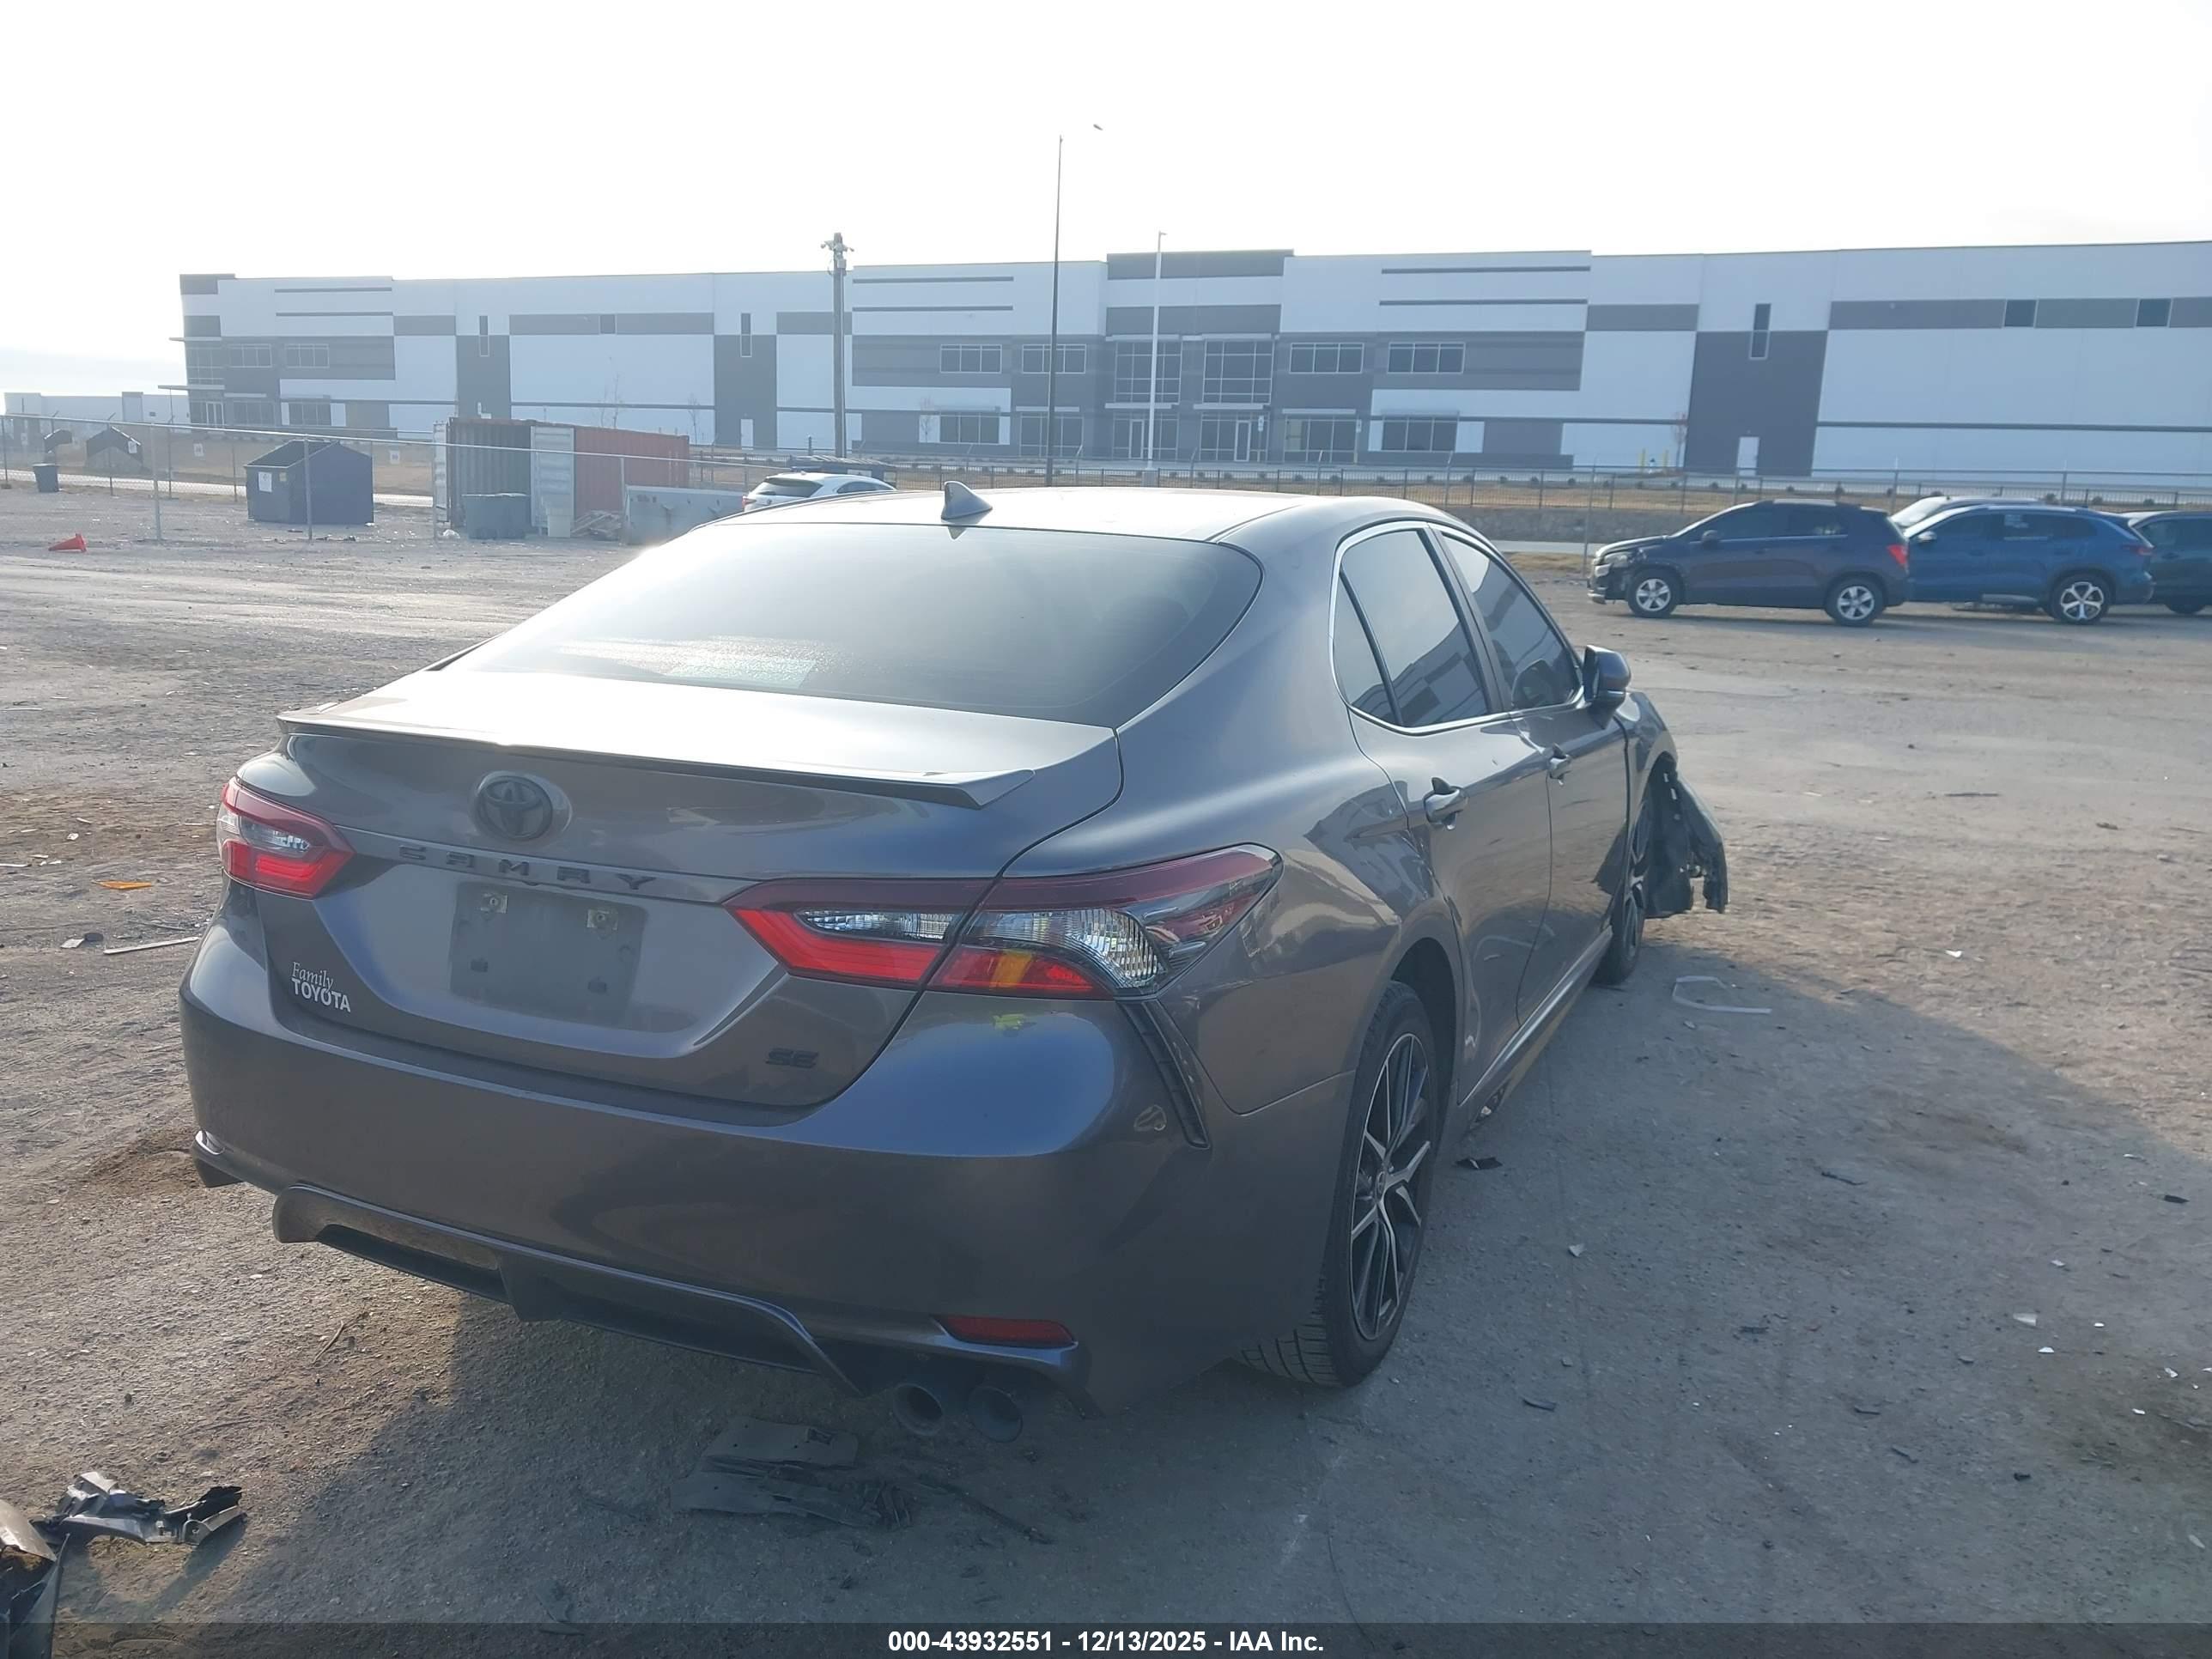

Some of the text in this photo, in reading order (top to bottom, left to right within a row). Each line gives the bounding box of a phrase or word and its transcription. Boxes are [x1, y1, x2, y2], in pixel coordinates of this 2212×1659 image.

[398, 844, 657, 890] CAMRY
[292, 961, 334, 994] Family
[291, 977, 351, 1013] TOYOTA
[765, 1048, 820, 1069] SE
